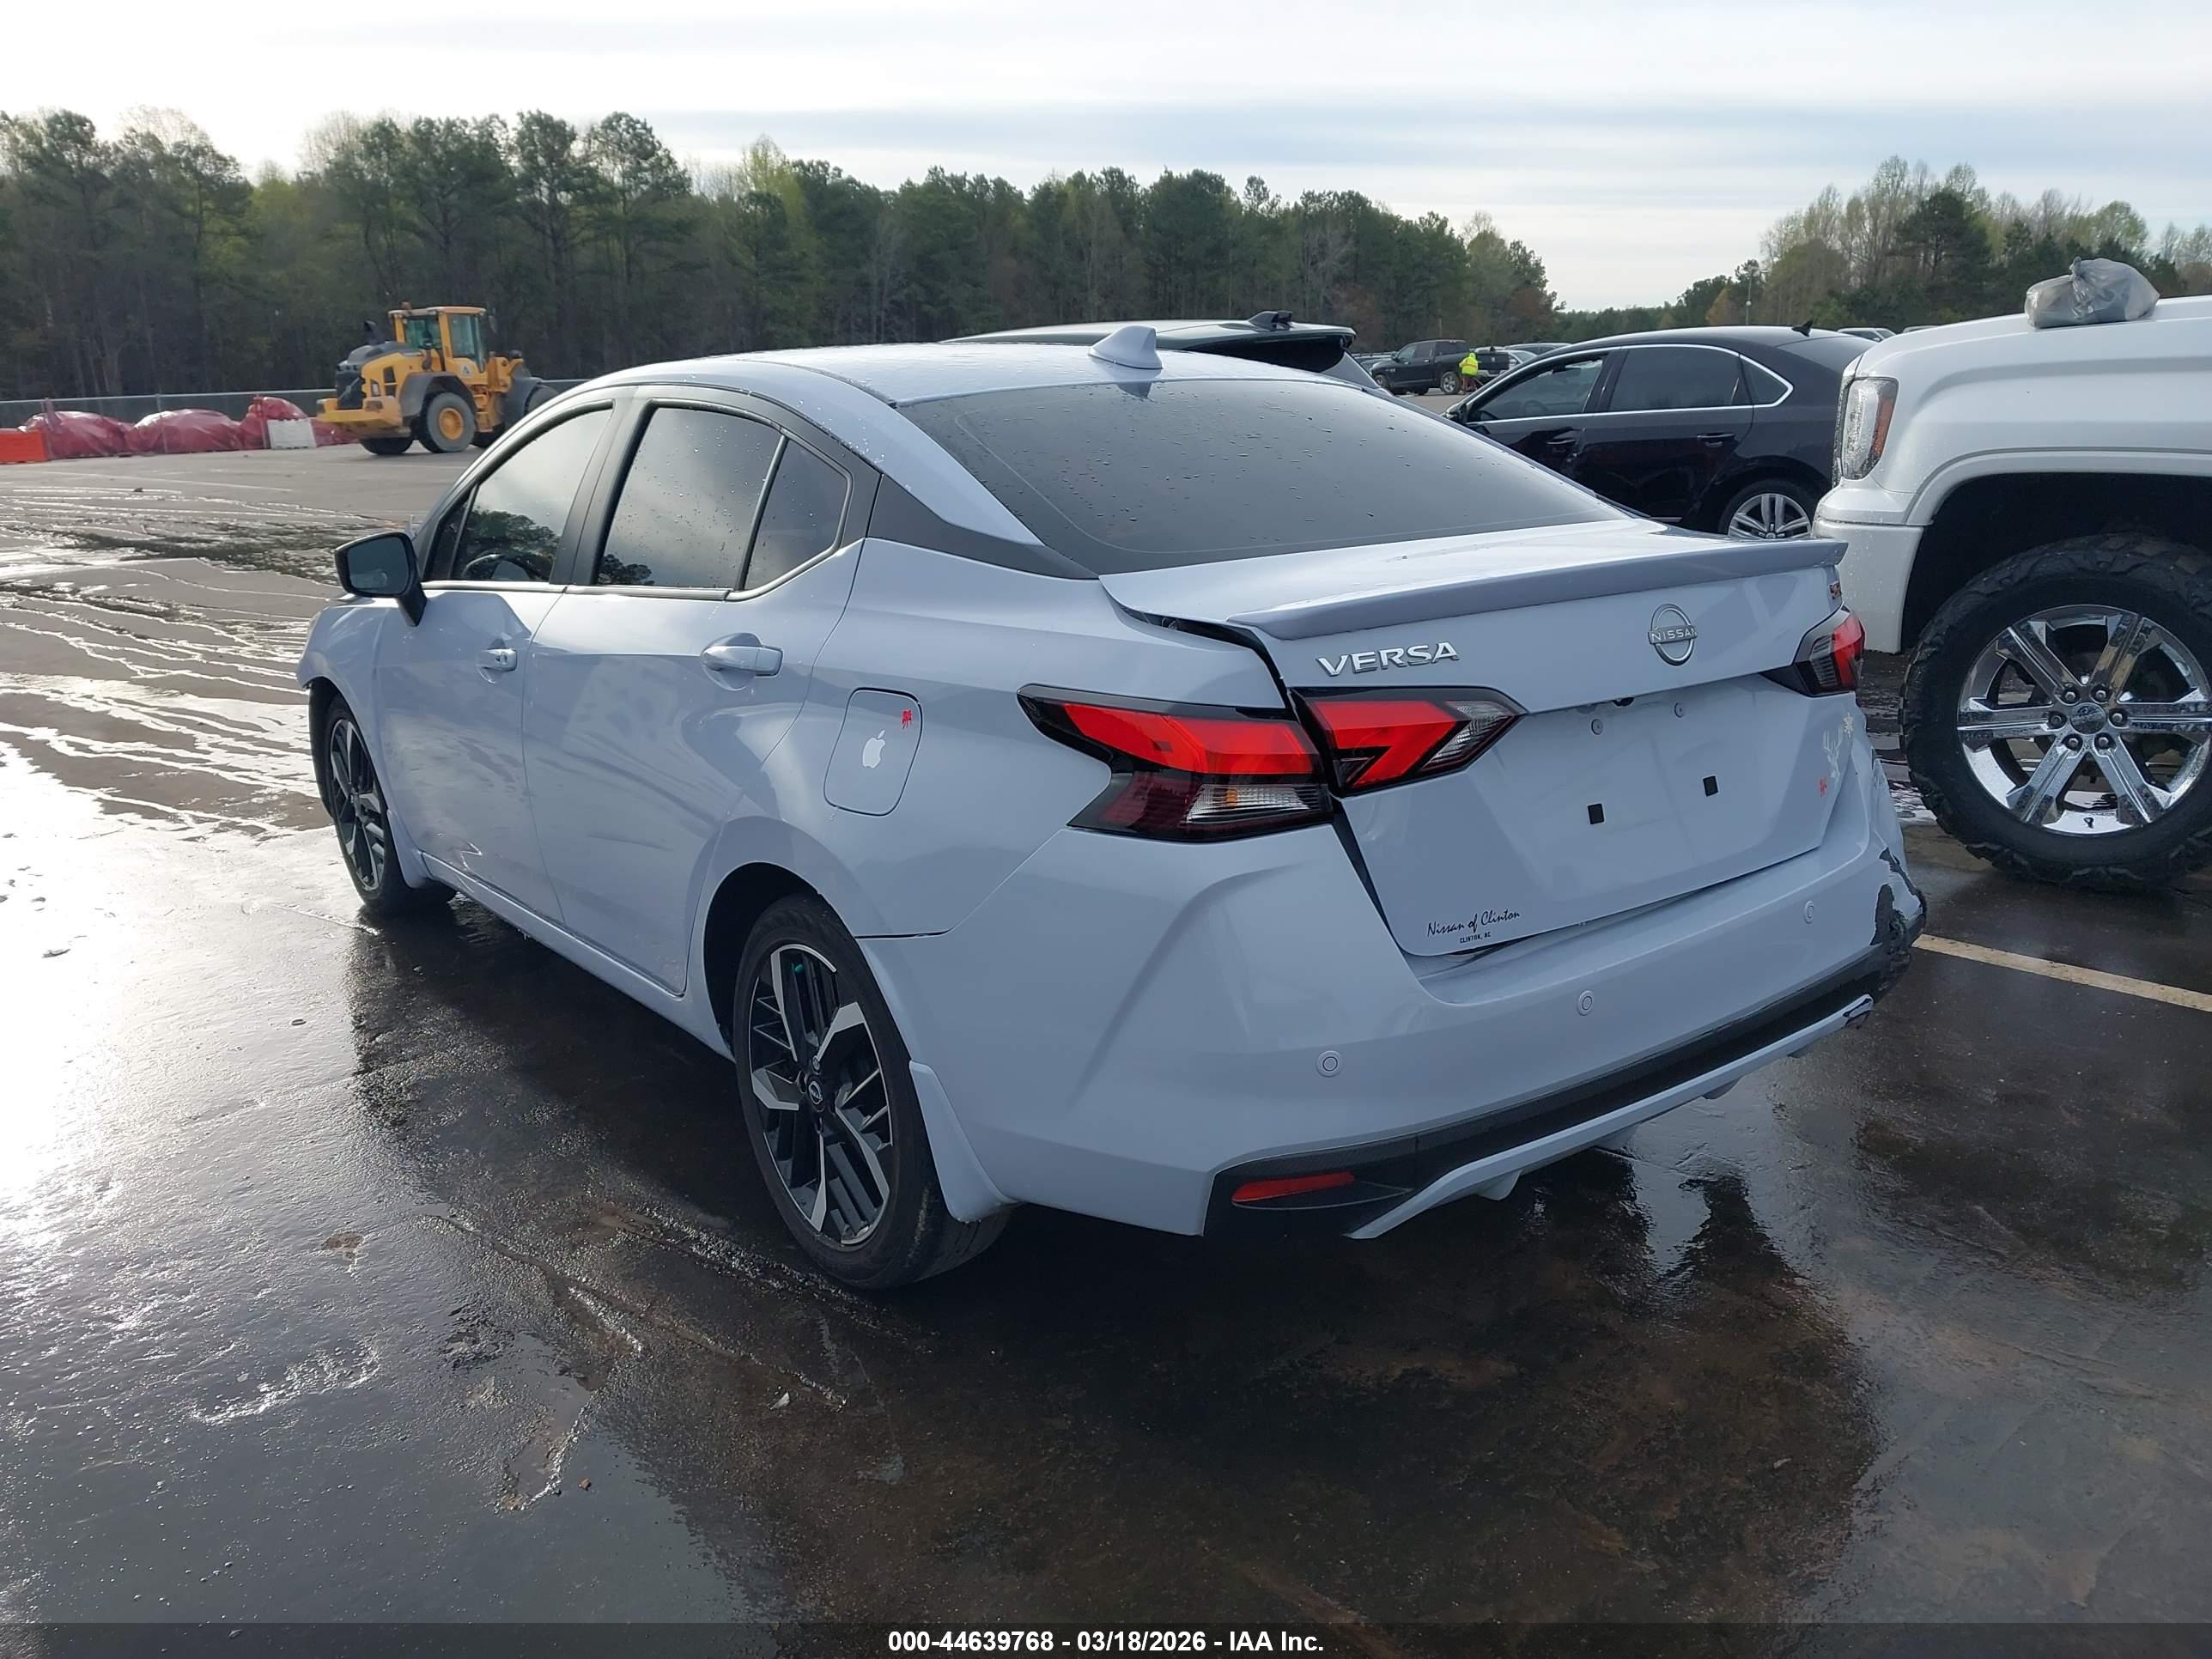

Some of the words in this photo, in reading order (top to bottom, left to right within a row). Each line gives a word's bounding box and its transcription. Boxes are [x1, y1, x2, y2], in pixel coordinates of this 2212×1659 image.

[1650, 627, 1698, 641] NISSAN
[1316, 641, 1461, 677] VERSA
[1427, 921, 1464, 938] Nissan
[1468, 913, 1478, 933] of
[1480, 909, 1521, 926] Clinton
